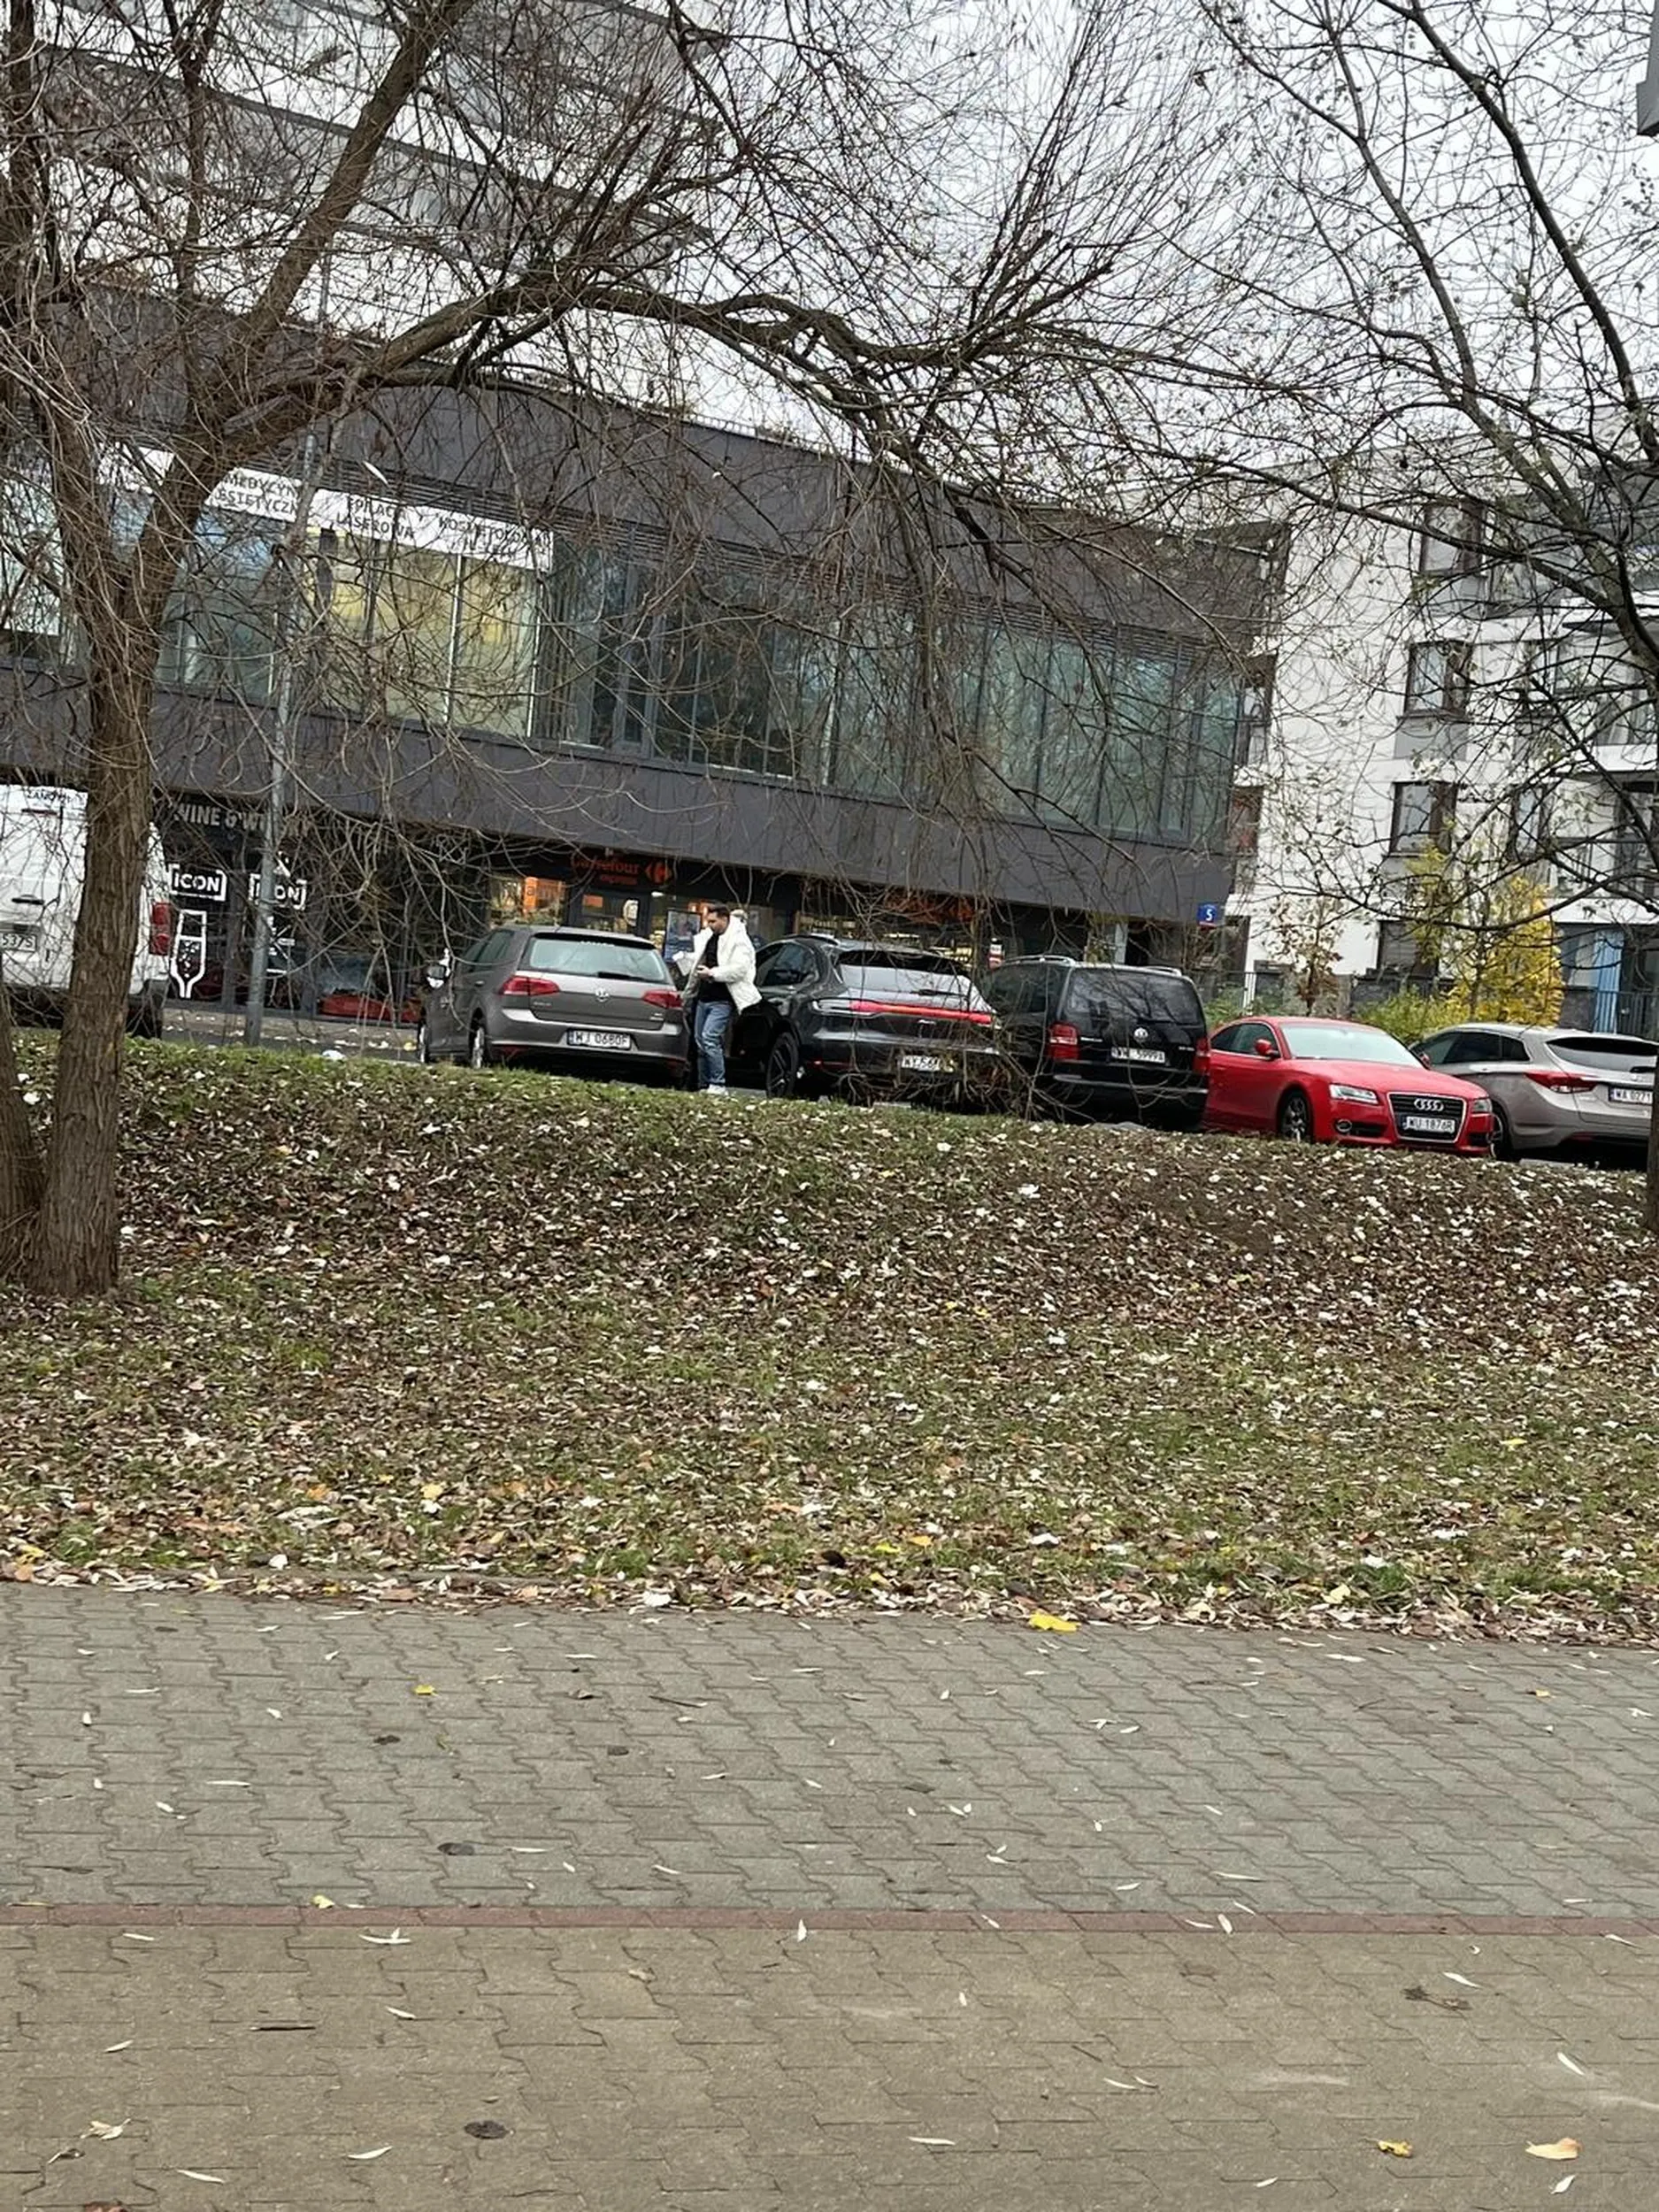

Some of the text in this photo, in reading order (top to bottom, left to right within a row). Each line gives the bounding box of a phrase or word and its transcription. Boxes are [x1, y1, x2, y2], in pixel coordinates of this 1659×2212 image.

[174, 872, 220, 893] ICON
[255, 882, 301, 902] ION
[1206, 909, 1213, 922] 5
